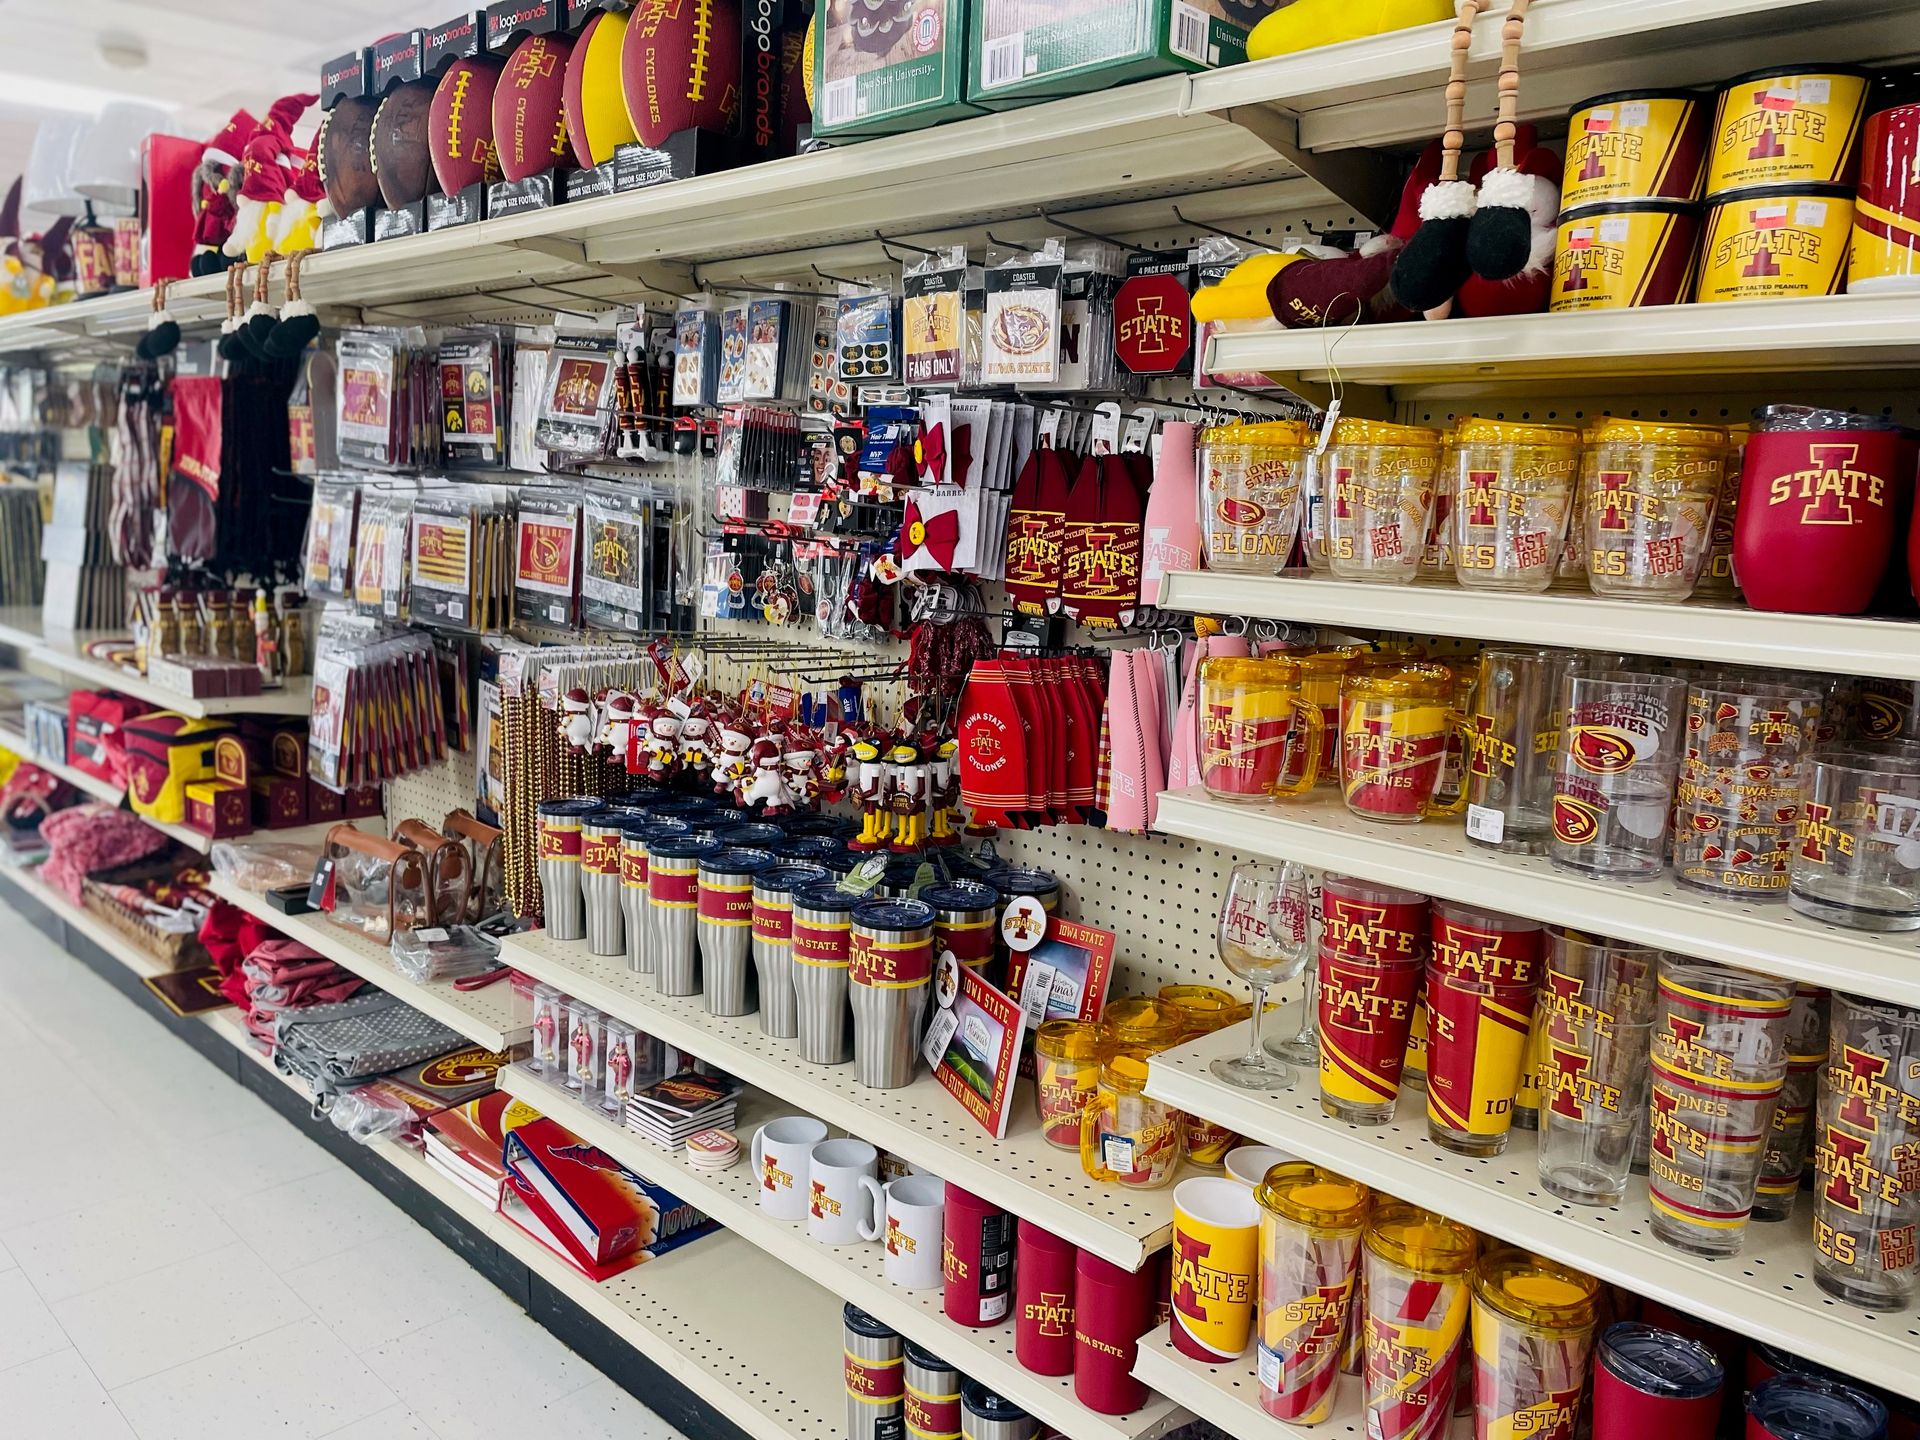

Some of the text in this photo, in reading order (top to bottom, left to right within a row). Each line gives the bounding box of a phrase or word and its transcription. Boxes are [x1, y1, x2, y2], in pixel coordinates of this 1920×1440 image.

[499, 5, 547, 29] logobrands
[432, 22, 472, 49] logobrands
[1027, 33, 1048, 50] Iowa
[1050, 29, 1073, 43] State
[381, 47, 416, 71] logobrands
[751, 0, 776, 147] ogobrands
[859, 80, 874, 92] Iowa
[876, 75, 893, 88] State
[645, 47, 661, 124] CYCLONES
[515, 97, 527, 164] CYCLONES
[1722, 109, 1826, 155] STATE
[1779, 163, 1814, 172] PEANUTS
[617, 175, 635, 187] JUNIOR
[635, 172, 646, 183] SIZE
[507, 197, 518, 208] SIZE
[518, 193, 544, 206] FOOTBALL
[567, 184, 592, 199] JUNIOR SIZE
[1714, 229, 1822, 270] STATE
[1012, 272, 1036, 282] COASTER
[1144, 264, 1158, 275] PACK
[1159, 262, 1190, 273] COASTERS
[911, 314, 951, 337] STATE
[1120, 315, 1182, 342] STATE
[908, 356, 956, 378] FANS ONLY
[1245, 460, 1285, 478] IOWA
[1245, 468, 1290, 490] STATE
[1769, 469, 1885, 507] STATE
[593, 543, 629, 568] STATE
[1008, 537, 1059, 565] STATE
[1517, 549, 1547, 569] 1858
[1068, 549, 1135, 577] STATE
[1650, 554, 1685, 576] 1858
[965, 712, 1006, 732] IOWA STATE
[1567, 712, 1649, 737] CYCLONES
[1748, 721, 1801, 738] STATE
[970, 737, 1001, 751] STATE
[1346, 732, 1418, 763] STATE
[968, 754, 1007, 772] CYCLONES
[1346, 767, 1413, 788] CYCLONES
[1731, 784, 1768, 798] IOWA
[1727, 826, 1781, 839] CYCLONES
[756, 918, 782, 930] STATE
[1004, 918, 1041, 936] STATE
[1059, 924, 1105, 946] IOWA STATE
[805, 939, 838, 951] STATE
[963, 976, 1010, 1024] IOWA STATE
[992, 1028, 1013, 1112] CYCLONES
[948, 1074, 963, 1099] STATE
[962, 1087, 990, 1127] UNIVERSITY
[1878, 1225, 1917, 1251] EST
[1881, 1247, 1916, 1272] 1858
[1092, 1339, 1124, 1359] STATE
[845, 1368, 875, 1391] STATE
